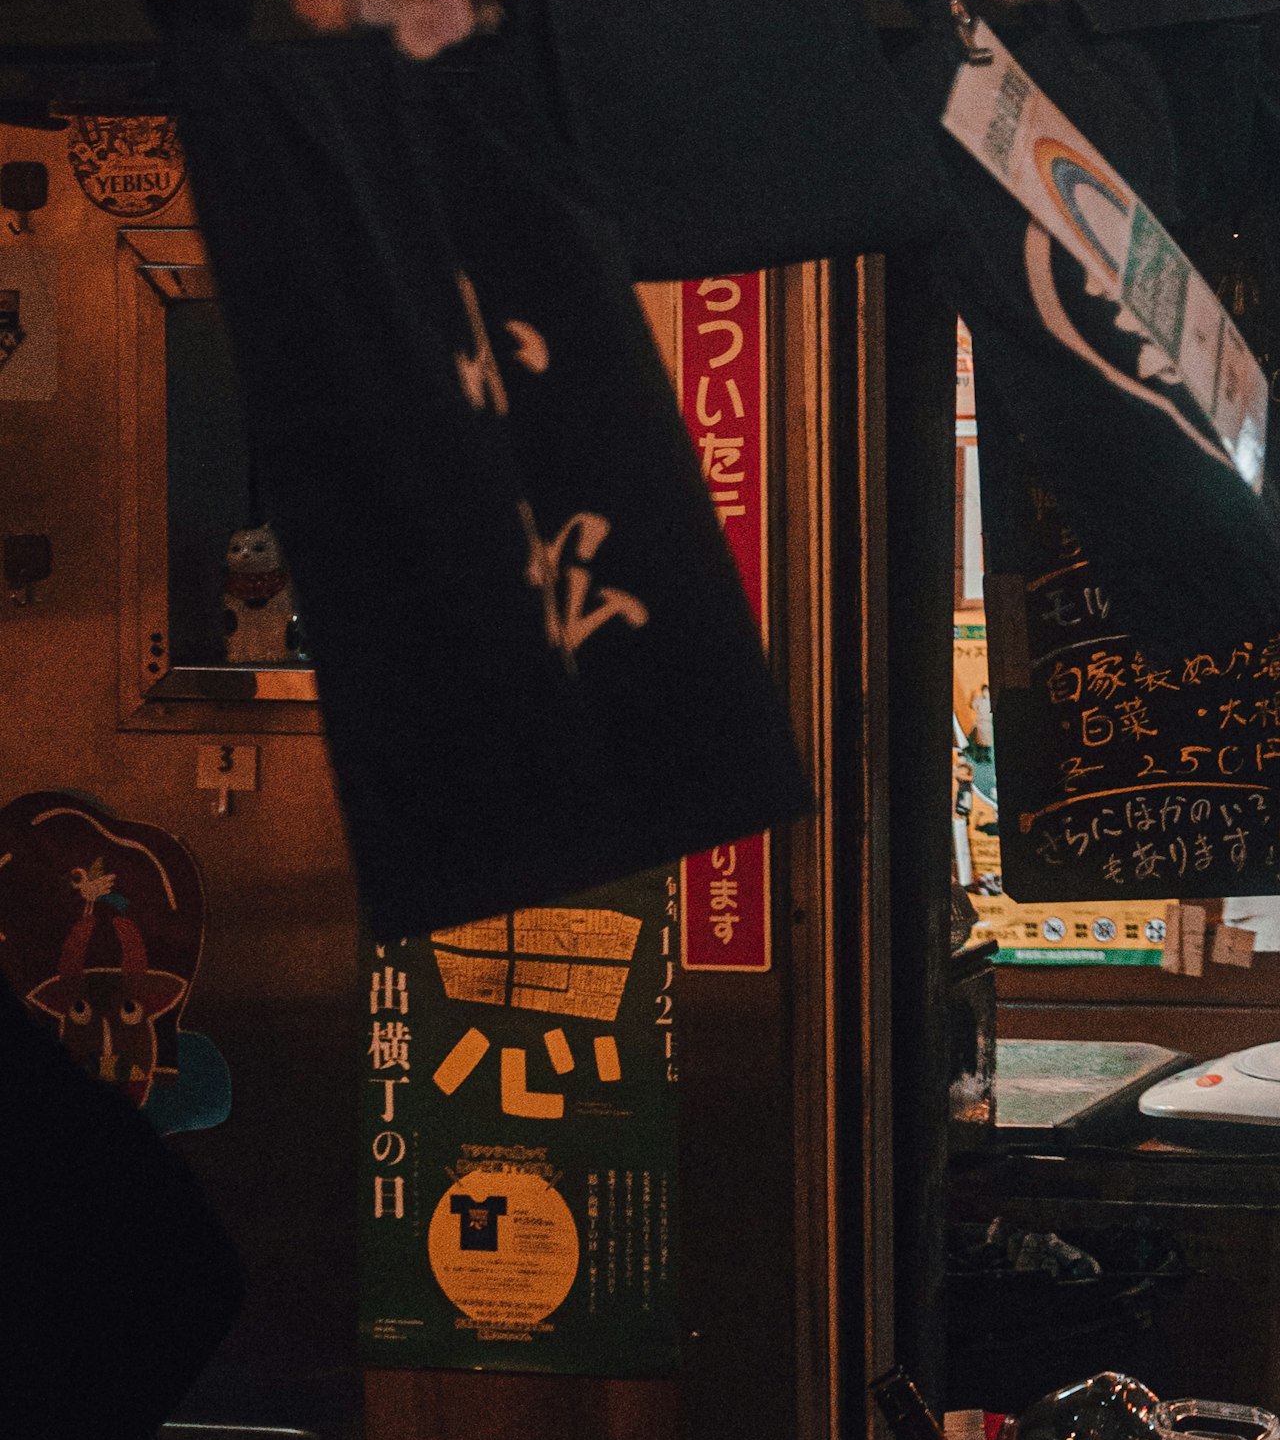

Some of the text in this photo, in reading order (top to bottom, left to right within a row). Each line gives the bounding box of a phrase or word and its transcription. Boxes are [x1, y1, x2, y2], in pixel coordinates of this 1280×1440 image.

[95, 172, 171, 194] YEBISU
[708, 843, 742, 946] ります
[367, 938, 413, 1220] 出横丁の日
